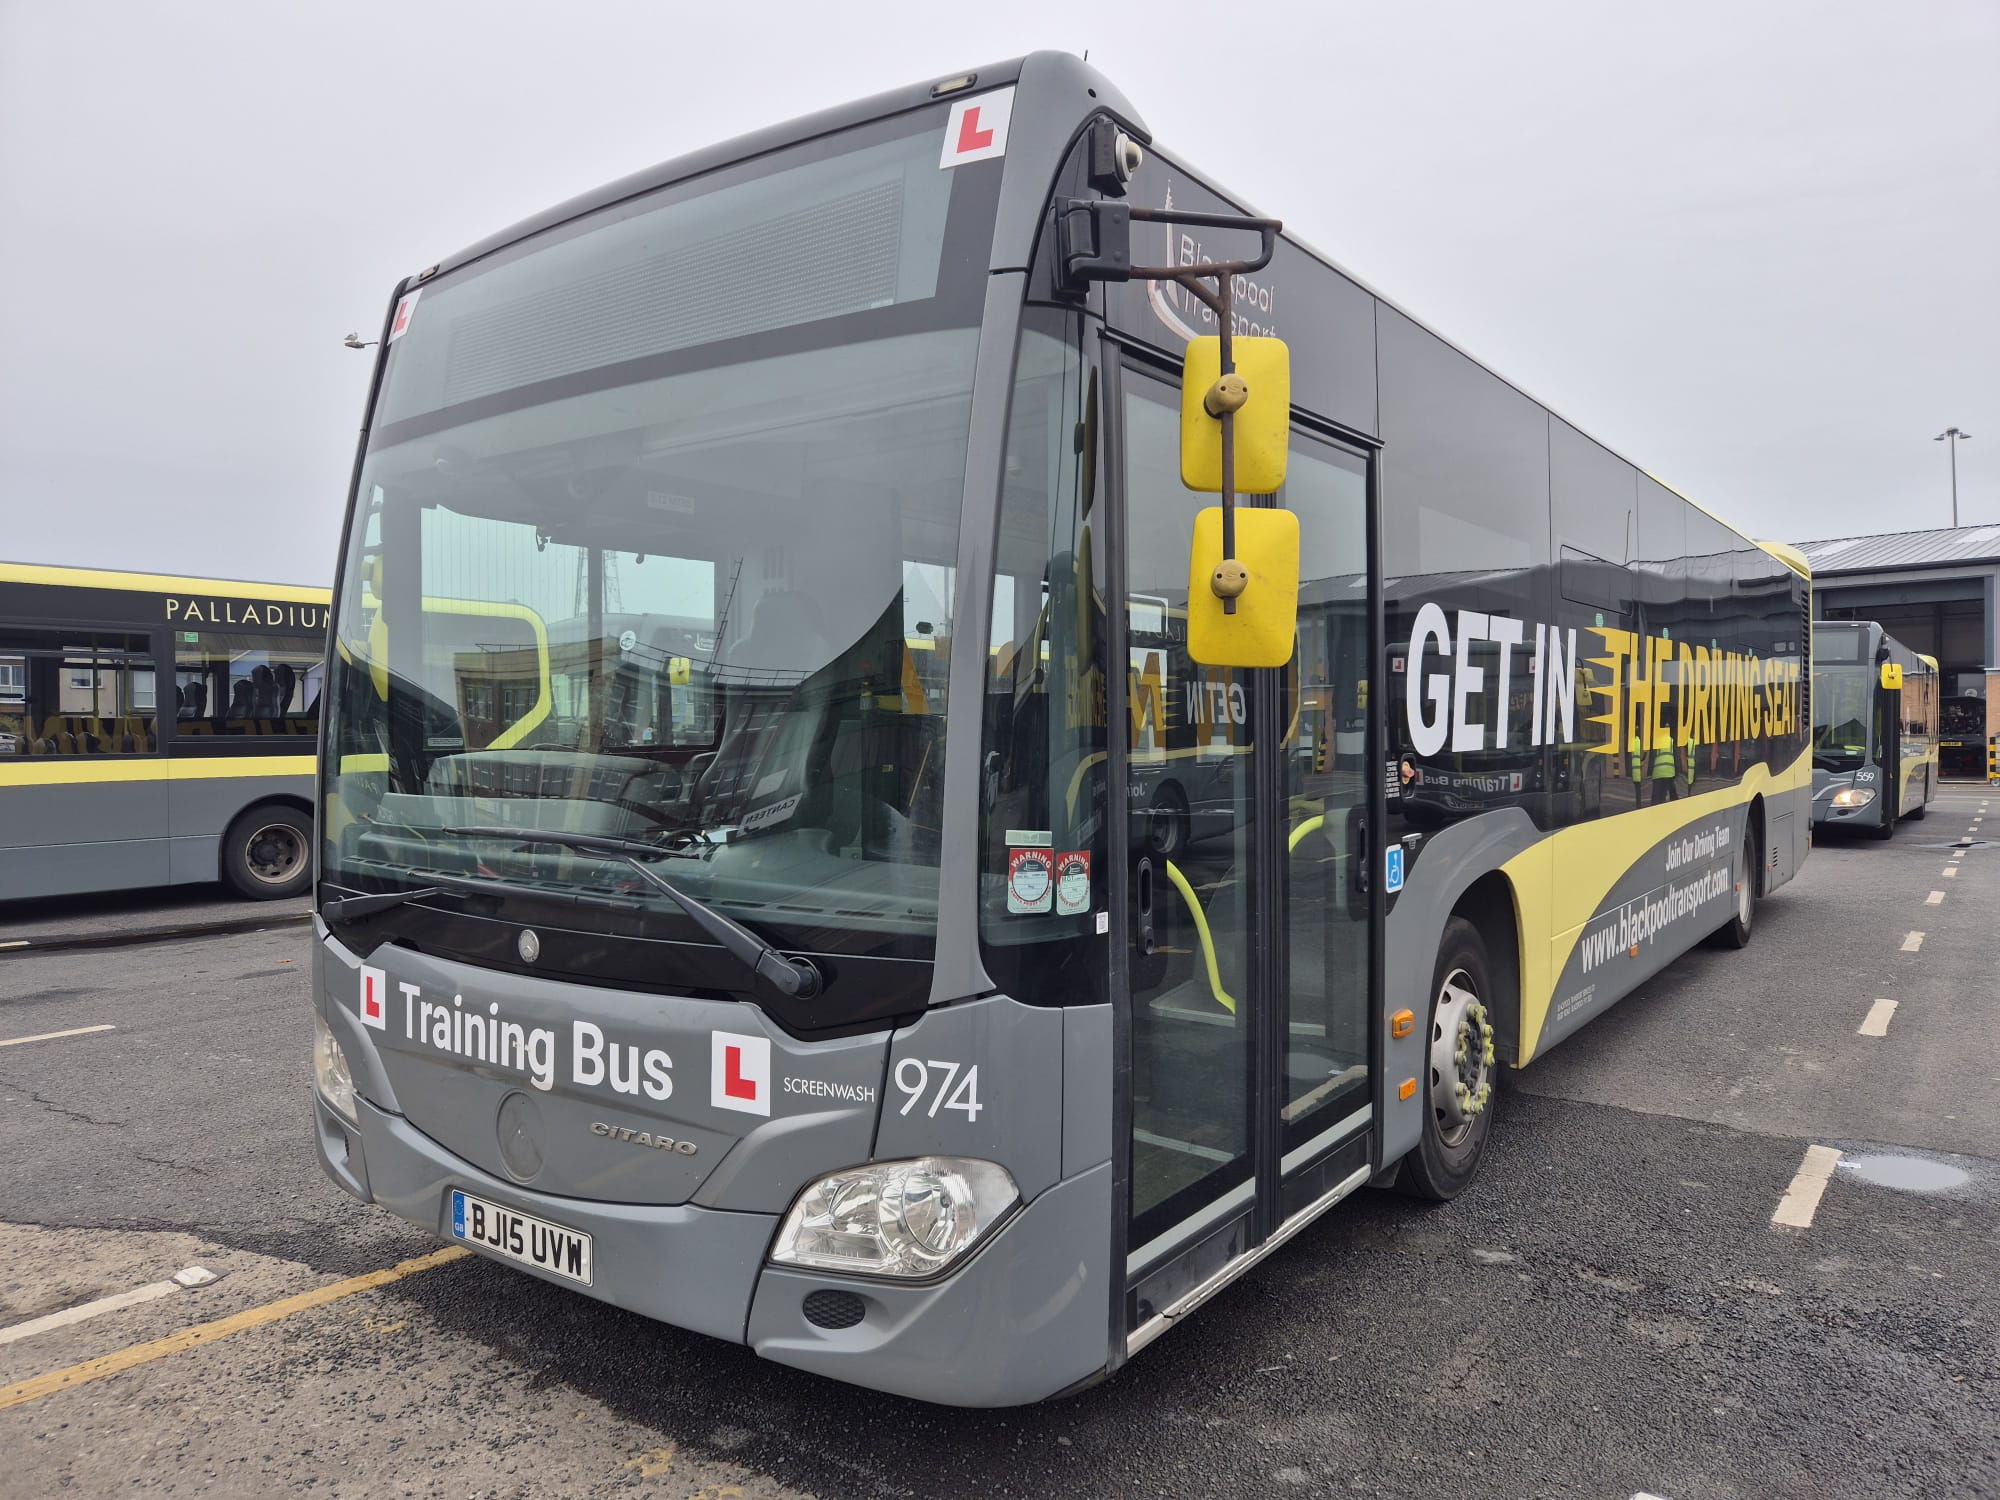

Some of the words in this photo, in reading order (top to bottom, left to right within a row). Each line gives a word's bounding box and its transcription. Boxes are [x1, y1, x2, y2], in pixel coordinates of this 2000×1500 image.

[956, 106, 994, 154] L
[1181, 233, 1275, 314] Blpool
[393, 301, 408, 334] L
[1407, 602, 1523, 757] GET
[1532, 623, 1576, 746] IN
[1585, 627, 1672, 754] THE
[1677, 642, 1760, 747] DRIVING
[1764, 658, 1799, 737] SEAT
[1856, 771, 1875, 782] 559
[1011, 851, 1052, 869] WARNING
[1058, 854, 1089, 871] WARNING
[1665, 841, 1681, 871] Join
[1682, 838, 1694, 864] Our
[1694, 829, 1714, 859] Driving
[1715, 825, 1730, 849] Team
[1581, 867, 1728, 974] www.blackpooltransport.com
[366, 976, 380, 1018] L
[399, 981, 555, 1091] Training
[573, 1021, 673, 1101] Bus
[725, 1045, 756, 1100] L
[783, 1077, 875, 1103] SCREENWASH
[894, 1058, 983, 1122] 974
[590, 1122, 698, 1156] CITARO
[454, 1221, 464, 1233] GB
[471, 1202, 524, 1255] BJ15
[531, 1223, 582, 1277] UVW
